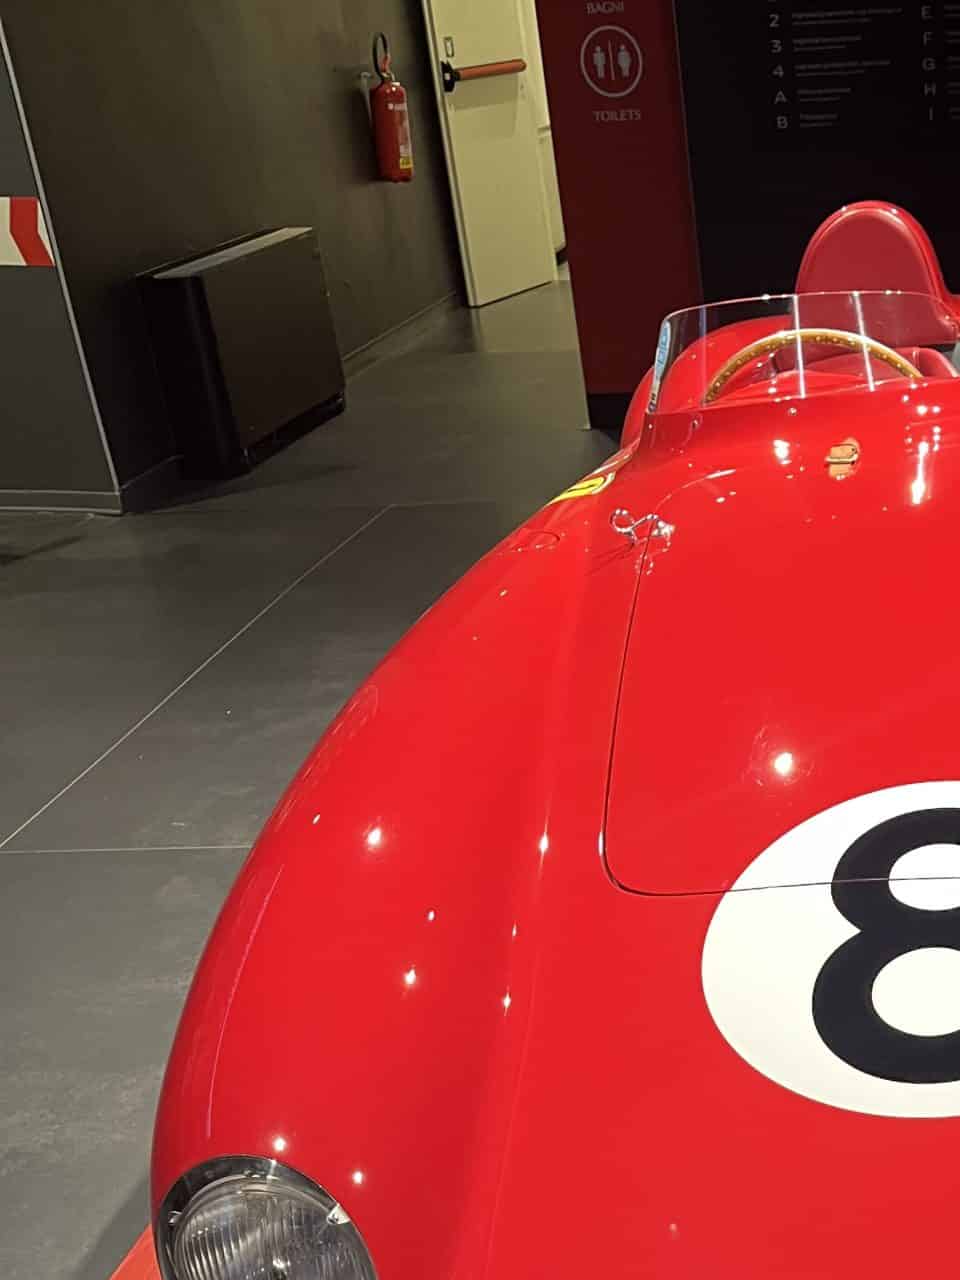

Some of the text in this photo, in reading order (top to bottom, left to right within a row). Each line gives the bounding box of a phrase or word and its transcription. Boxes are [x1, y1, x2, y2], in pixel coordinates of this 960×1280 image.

[586, 1, 624, 15] BAGNI
[922, 6, 931, 19] E
[770, 14, 780, 27] 2
[771, 40, 782, 54] 3
[772, 66, 784, 78] 4
[924, 84, 937, 96] H
[774, 91, 787, 104] A
[593, 109, 640, 122] TOILETS
[777, 116, 788, 129] B
